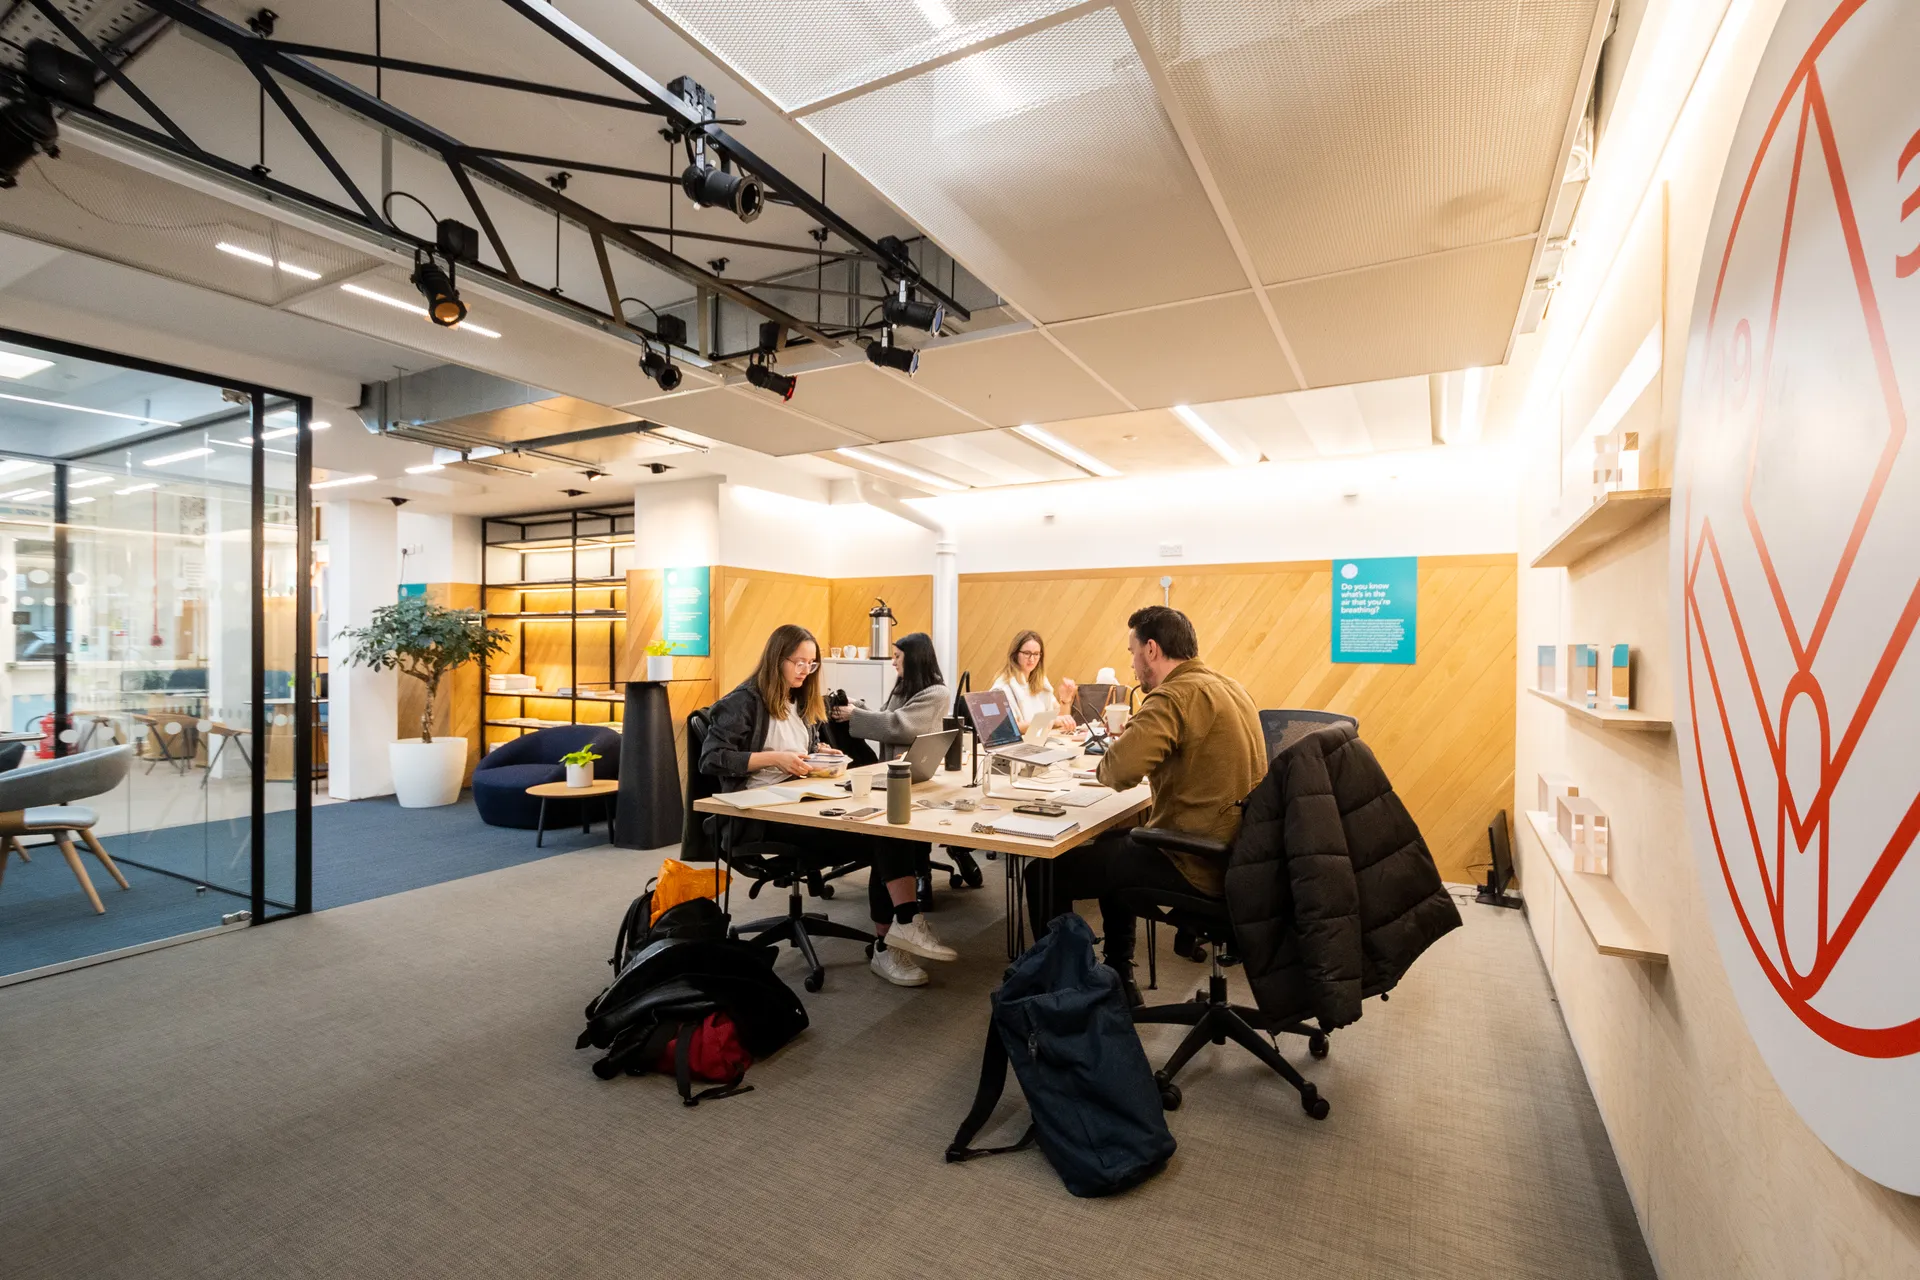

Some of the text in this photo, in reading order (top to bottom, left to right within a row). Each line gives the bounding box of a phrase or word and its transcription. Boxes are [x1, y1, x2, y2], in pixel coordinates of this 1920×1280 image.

[1353, 584, 1368, 592] you
[1369, 582, 1390, 590] know
[1367, 598, 1391, 607] you're
[1341, 606, 1380, 615] breathing?
